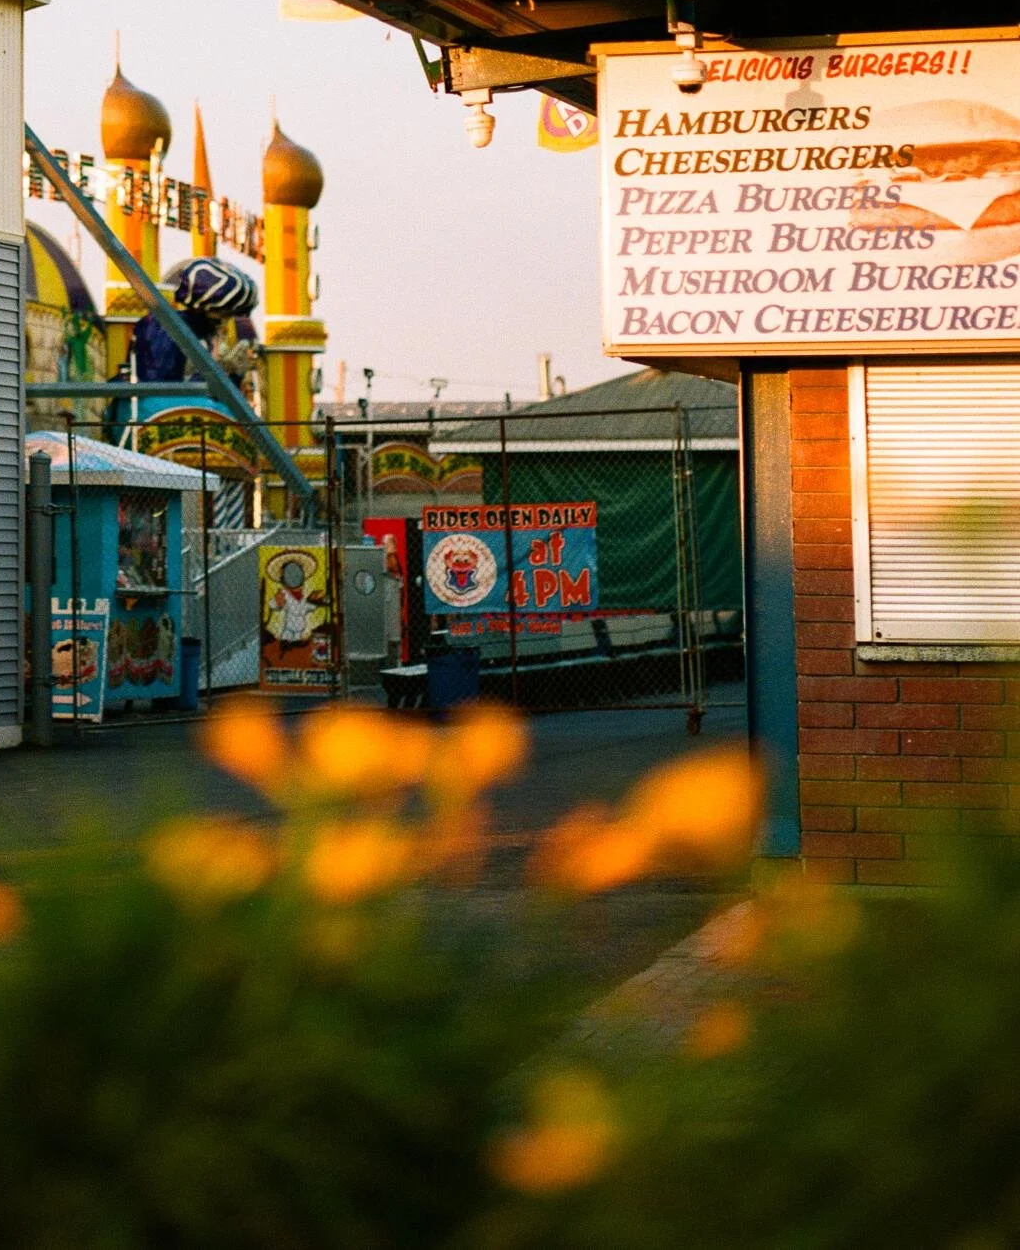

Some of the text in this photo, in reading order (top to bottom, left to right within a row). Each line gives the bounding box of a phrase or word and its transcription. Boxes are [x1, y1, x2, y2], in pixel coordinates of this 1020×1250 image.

[705, 50, 972, 83] ELICIOUS BURGERS!!
[614, 105, 872, 138] HAMBURGERS
[613, 144, 916, 177] CHEESEBURGERS
[616, 183, 903, 216] PIZZA BURGERS
[617, 222, 936, 257] PEPPER BURGERS
[618, 261, 1019, 297] MUSHROOM BURGERS
[619, 303, 1020, 336] BACON CHEESEBURGE
[427, 507, 592, 528] RIDES OPEN DAILY
[529, 531, 565, 566] at
